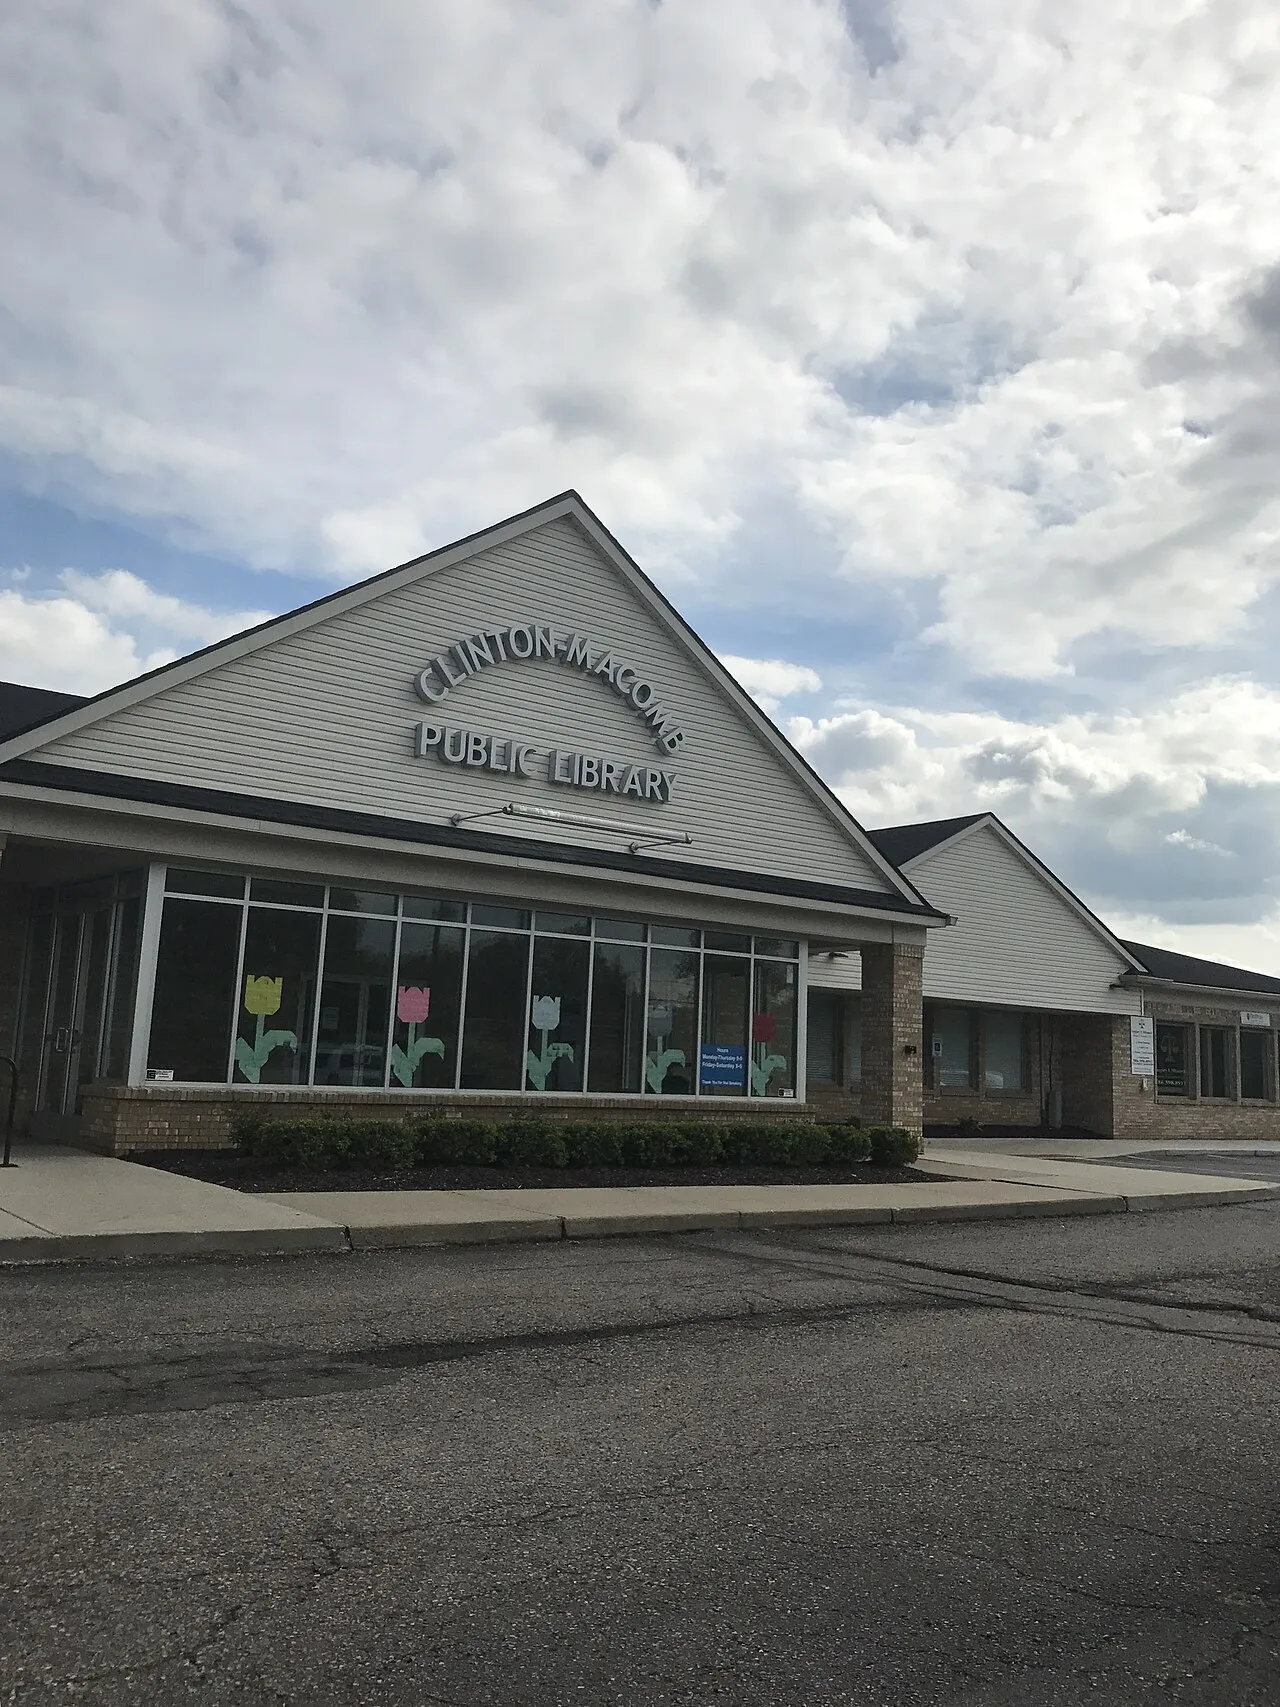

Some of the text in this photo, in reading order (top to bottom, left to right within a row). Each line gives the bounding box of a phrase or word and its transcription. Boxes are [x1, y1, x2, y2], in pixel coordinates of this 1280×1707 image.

[414, 625, 687, 756] CLINTON-MACOMB
[415, 721, 679, 803] PUBLIC LIBRARY
